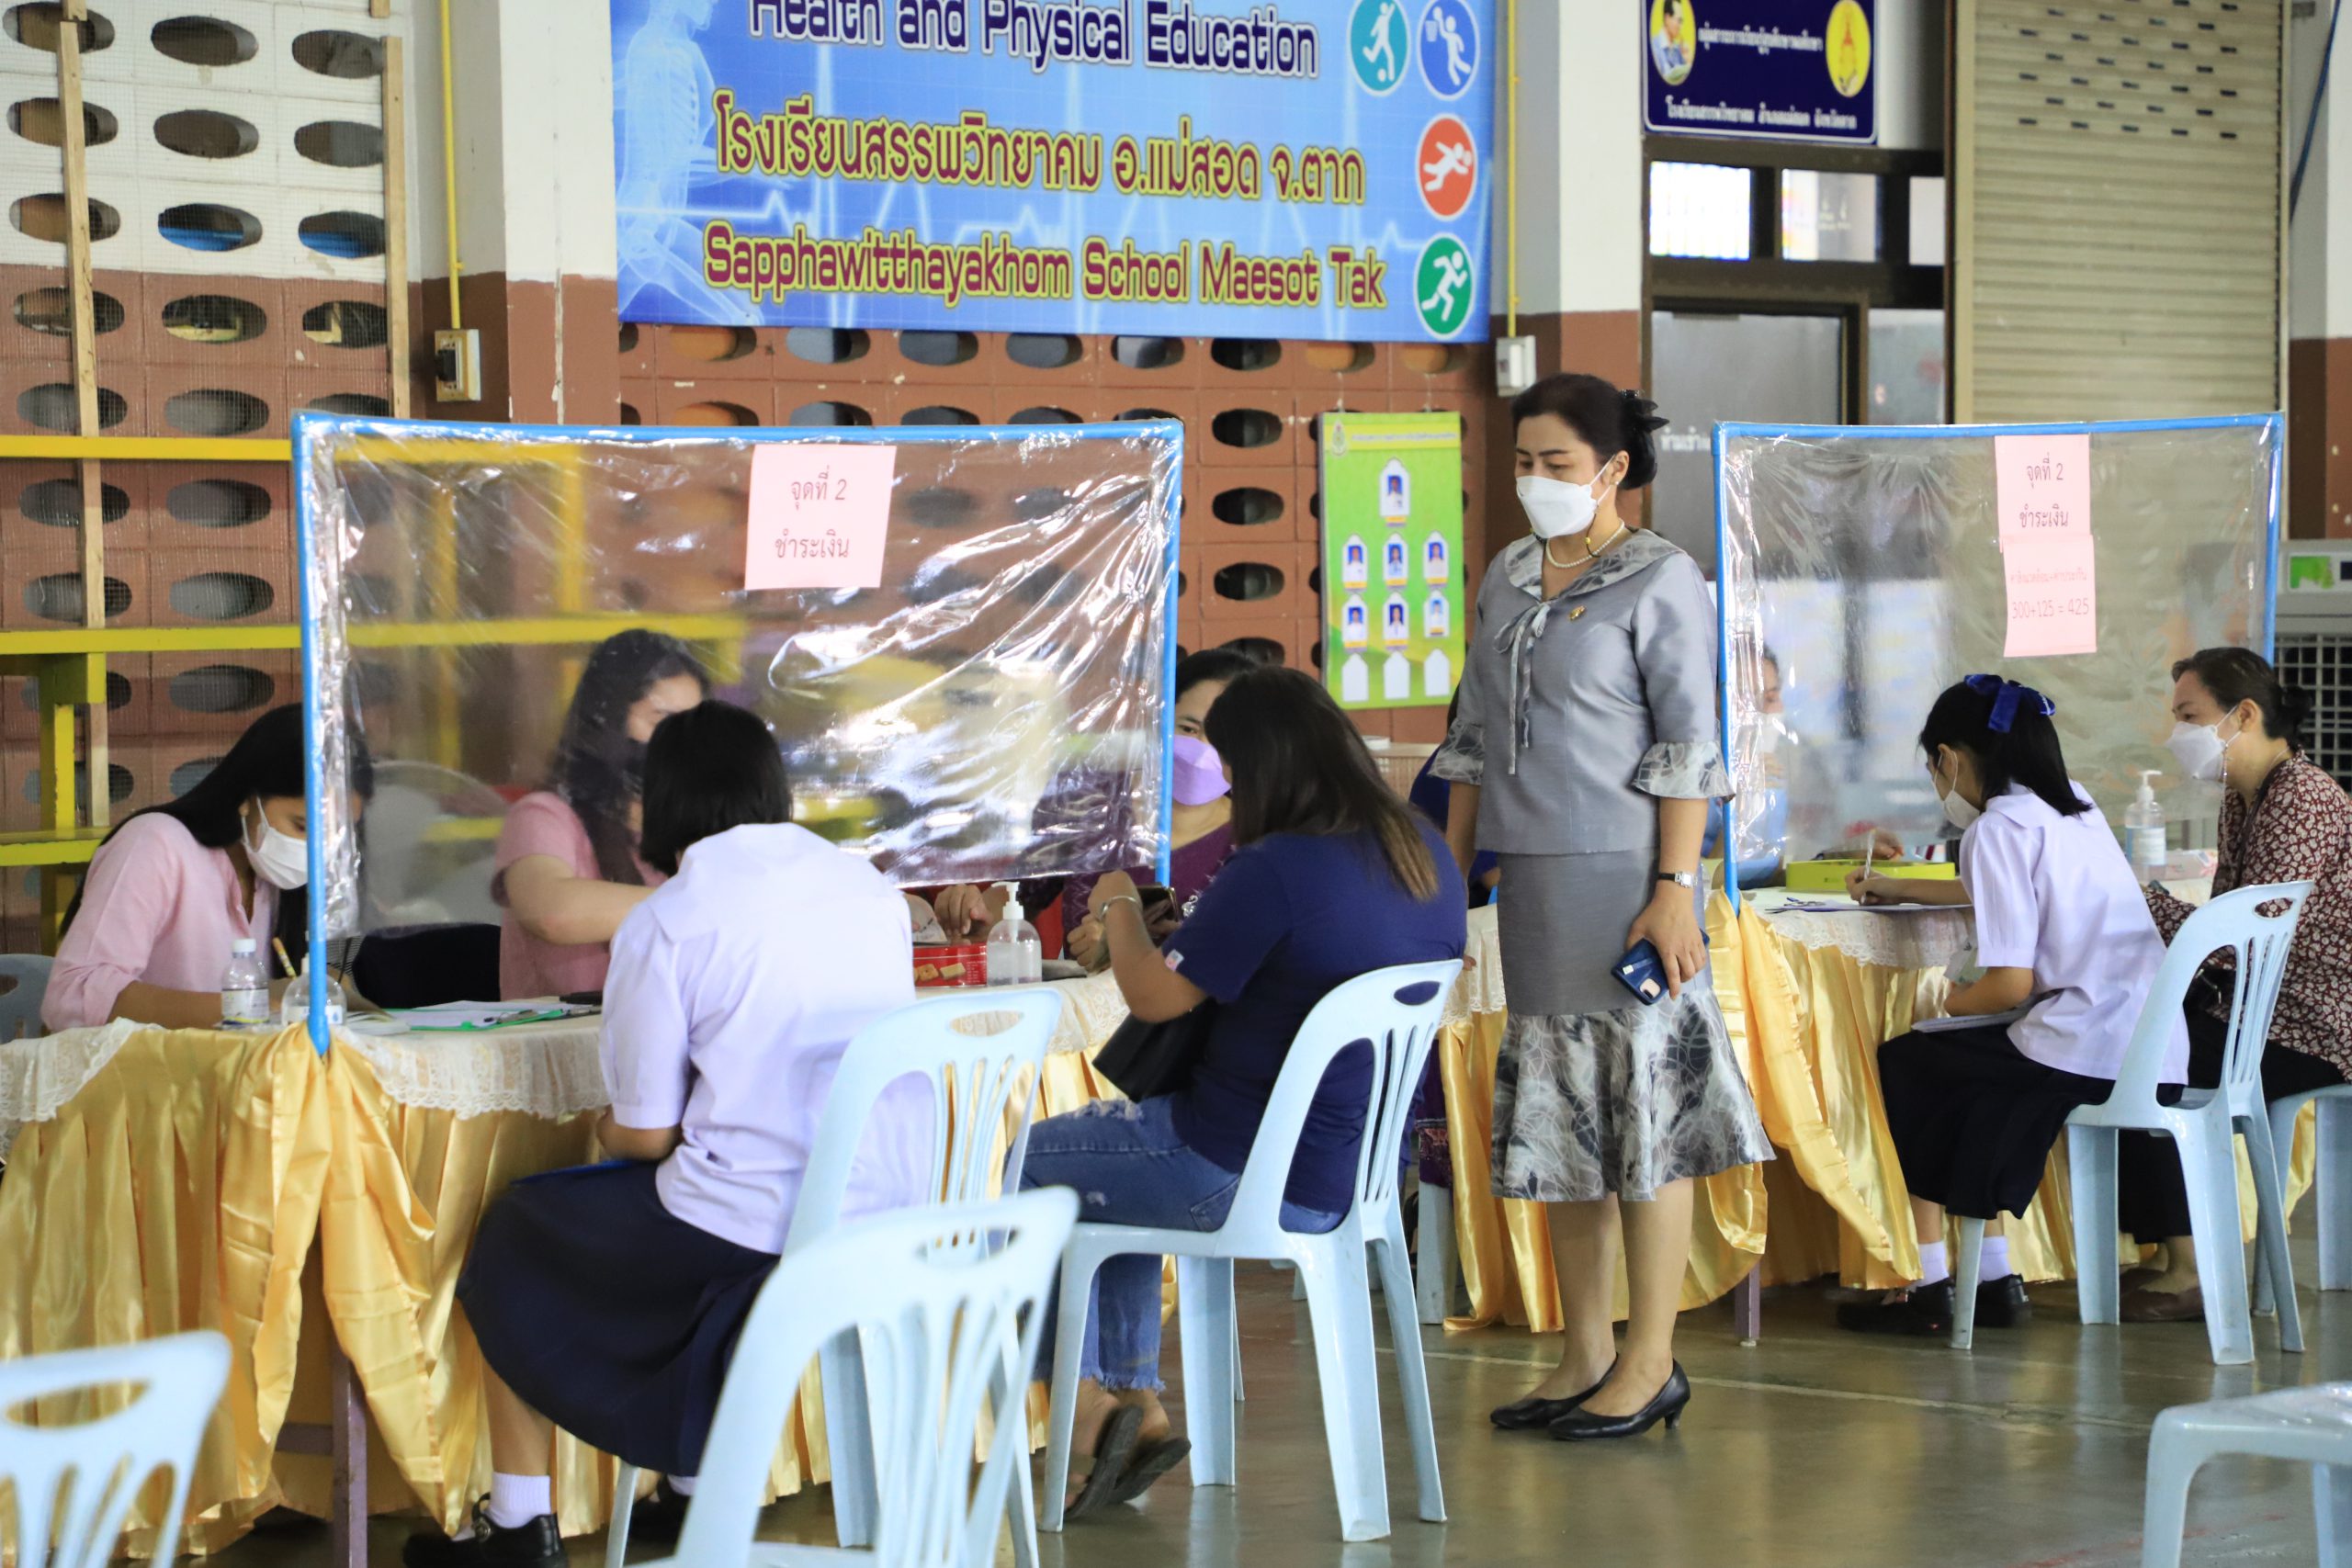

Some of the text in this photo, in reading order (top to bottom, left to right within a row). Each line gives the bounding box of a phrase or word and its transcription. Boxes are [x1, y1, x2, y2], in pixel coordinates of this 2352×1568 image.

[750, 0, 1319, 77] Health and Physical Education
[713, 88, 1366, 204] โรงเรียนสรรพวิทยาคม อ.แม่สอด จ.ตาก
[704, 220, 1387, 309] Sapphawitthayakhom School Maesot Tak
[791, 465, 847, 511] จุดที่ 2
[2027, 452, 2064, 489] จุดที่ 2
[2019, 503, 2068, 528] ชำระเงิน
[775, 528, 850, 558] ชำระเงิน
